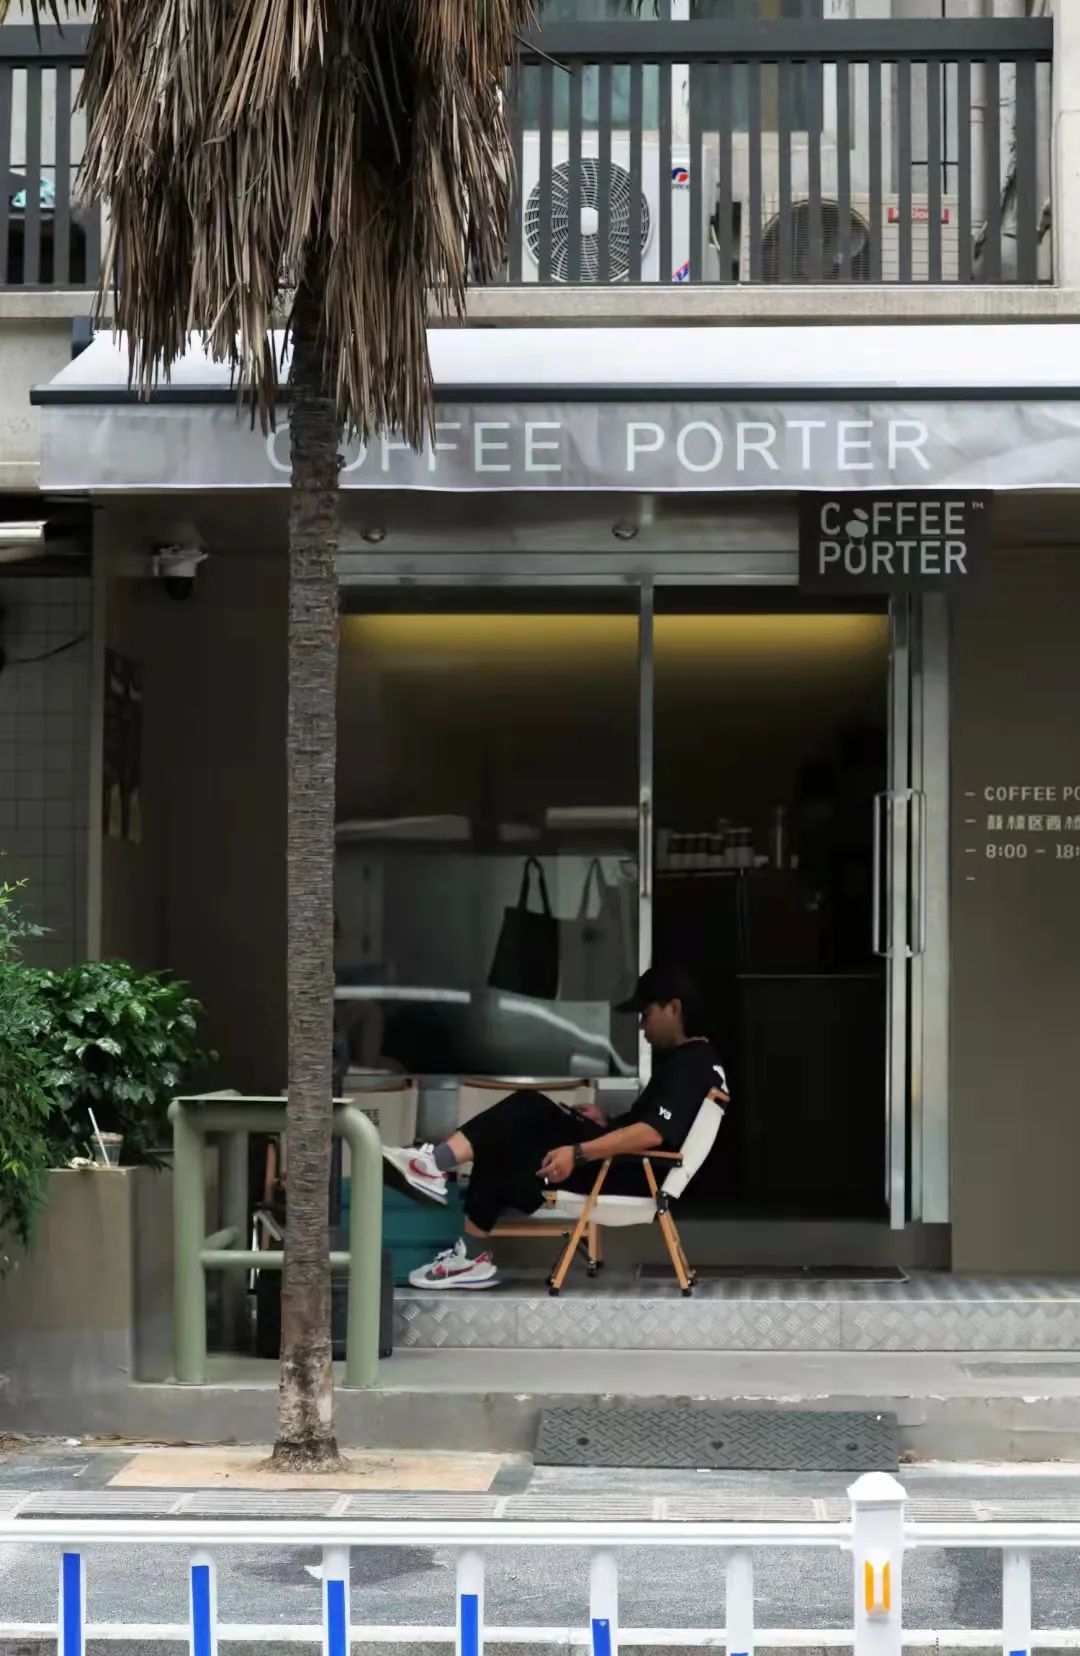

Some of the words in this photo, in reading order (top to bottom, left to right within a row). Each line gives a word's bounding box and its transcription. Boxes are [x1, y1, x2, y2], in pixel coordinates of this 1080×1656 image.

[625, 420, 931, 472] PORTER
[819, 540, 968, 575] PORTER
[984, 786, 1057, 801] COFFEE
[986, 844, 1028, 859] 8:00
